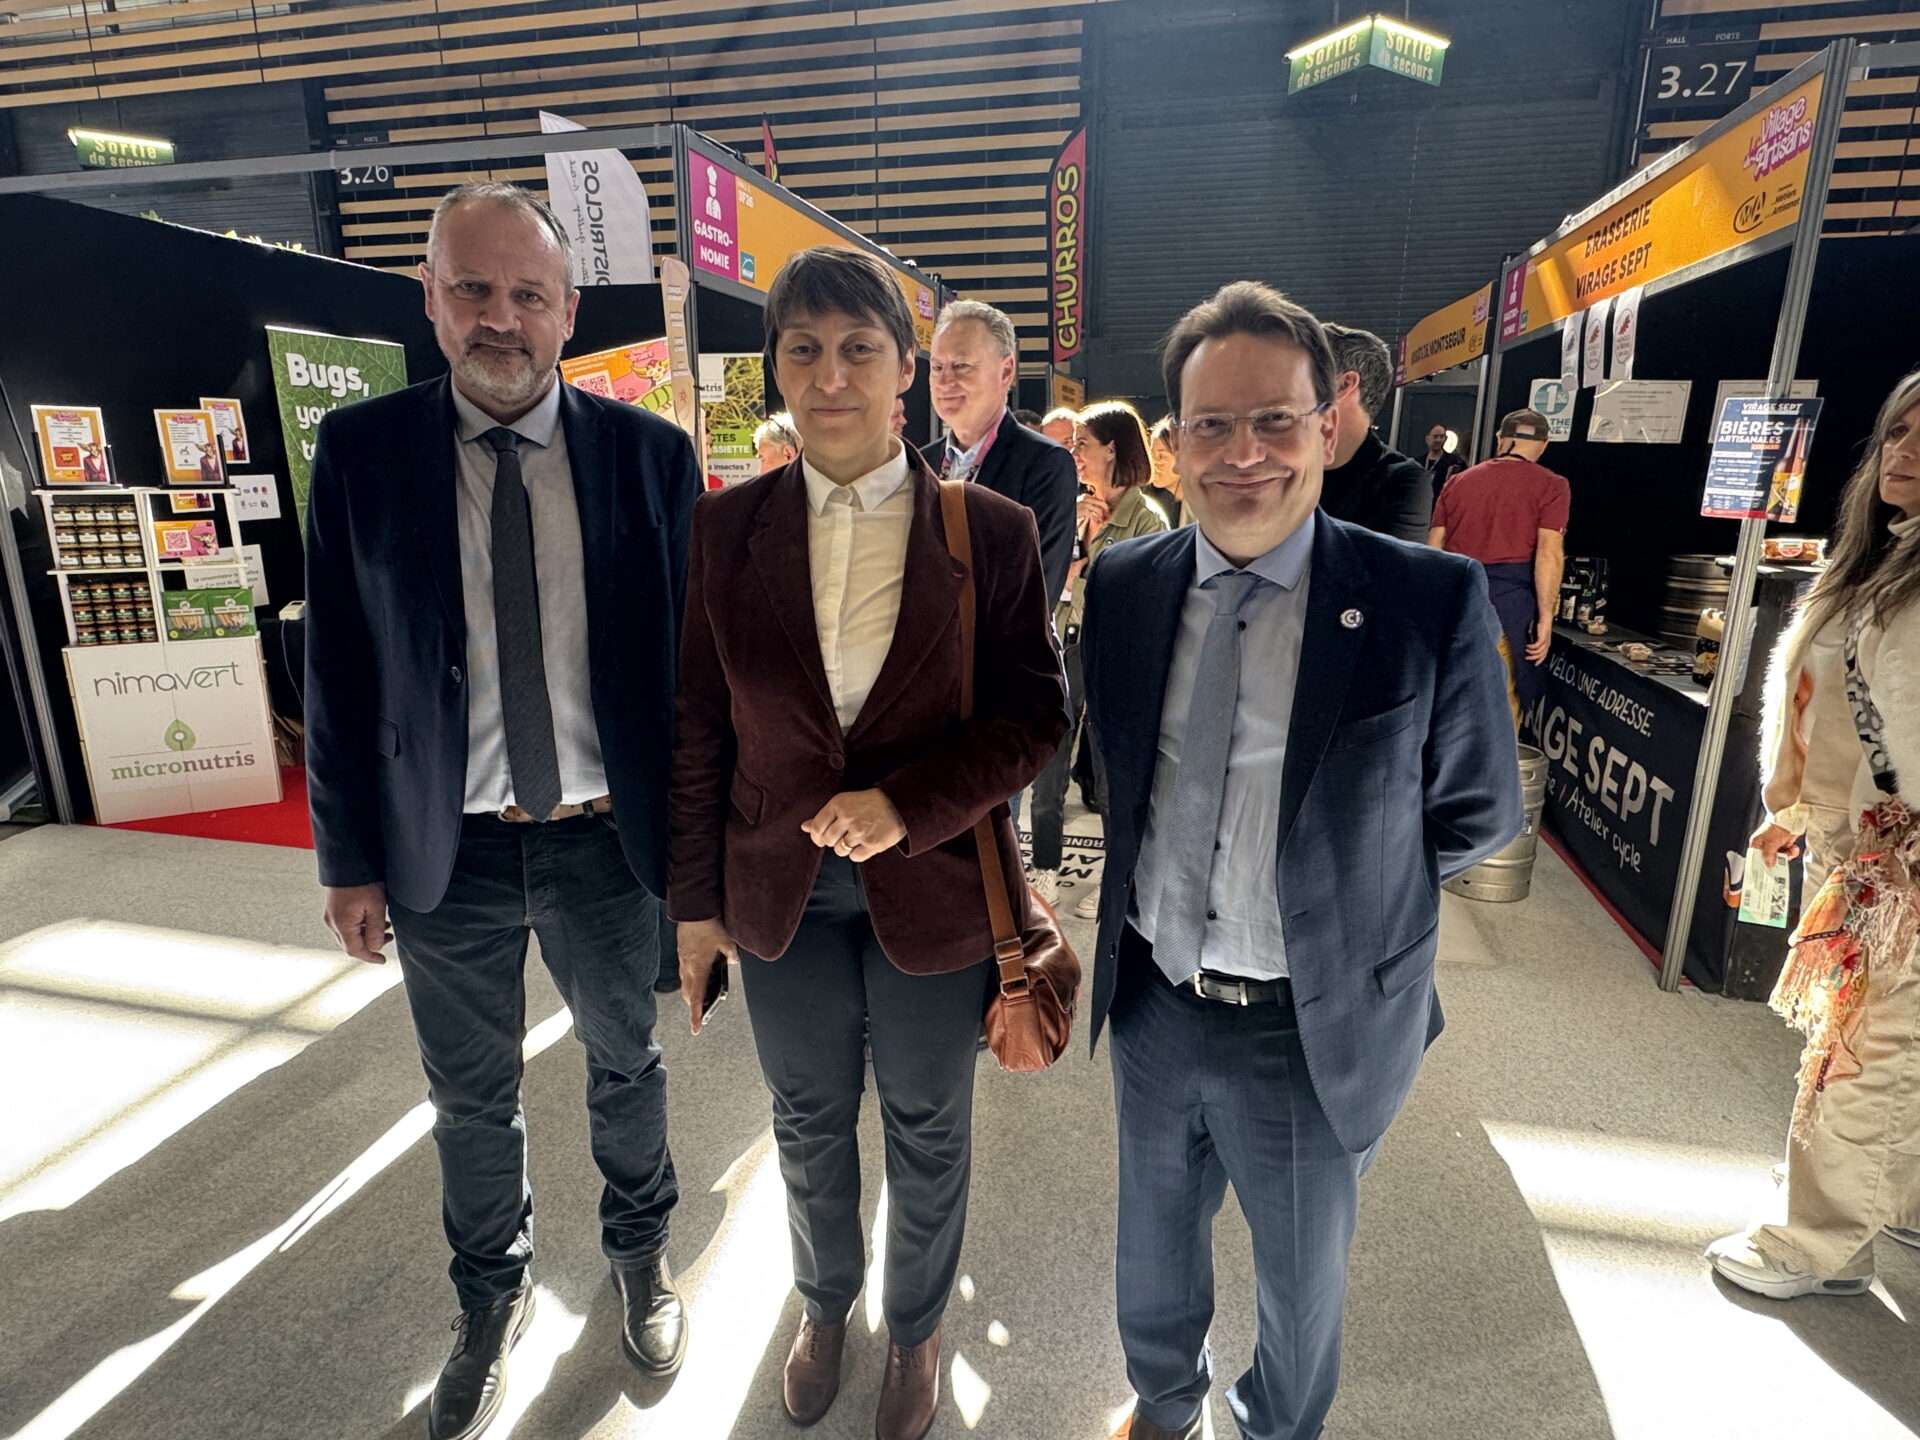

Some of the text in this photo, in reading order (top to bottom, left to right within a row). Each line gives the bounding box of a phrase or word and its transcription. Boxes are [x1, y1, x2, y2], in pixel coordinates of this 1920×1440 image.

[1305, 33, 1358, 69] Sortie
[1386, 31, 1432, 62] Sortie
[1666, 32, 1740, 44] HALL PORTE
[1296, 52, 1361, 88] de secours
[1378, 50, 1433, 81] de secours
[1657, 61, 1747, 99] 3.27
[95, 140, 157, 159] Sortie
[341, 165, 389, 184] 3.26
[694, 221, 733, 247] GASTRO-
[700, 245, 730, 270] NOMIE
[1055, 164, 1080, 349] CHURROS
[1576, 242, 1652, 299] VIRAGE SEPT
[286, 353, 369, 397] Bugs,
[1780, 402, 1803, 412] SEPT
[1718, 435, 1782, 444] ARTISANALES
[93, 661, 244, 697] nimavert
[1578, 669, 1601, 701] UNE
[1597, 685, 1655, 738] ADRESSE.
[111, 750, 256, 781] micronutris
[1584, 736, 1676, 847] SEPT
[1566, 785, 1609, 841] Atelier
[1612, 832, 1641, 873] cycle
